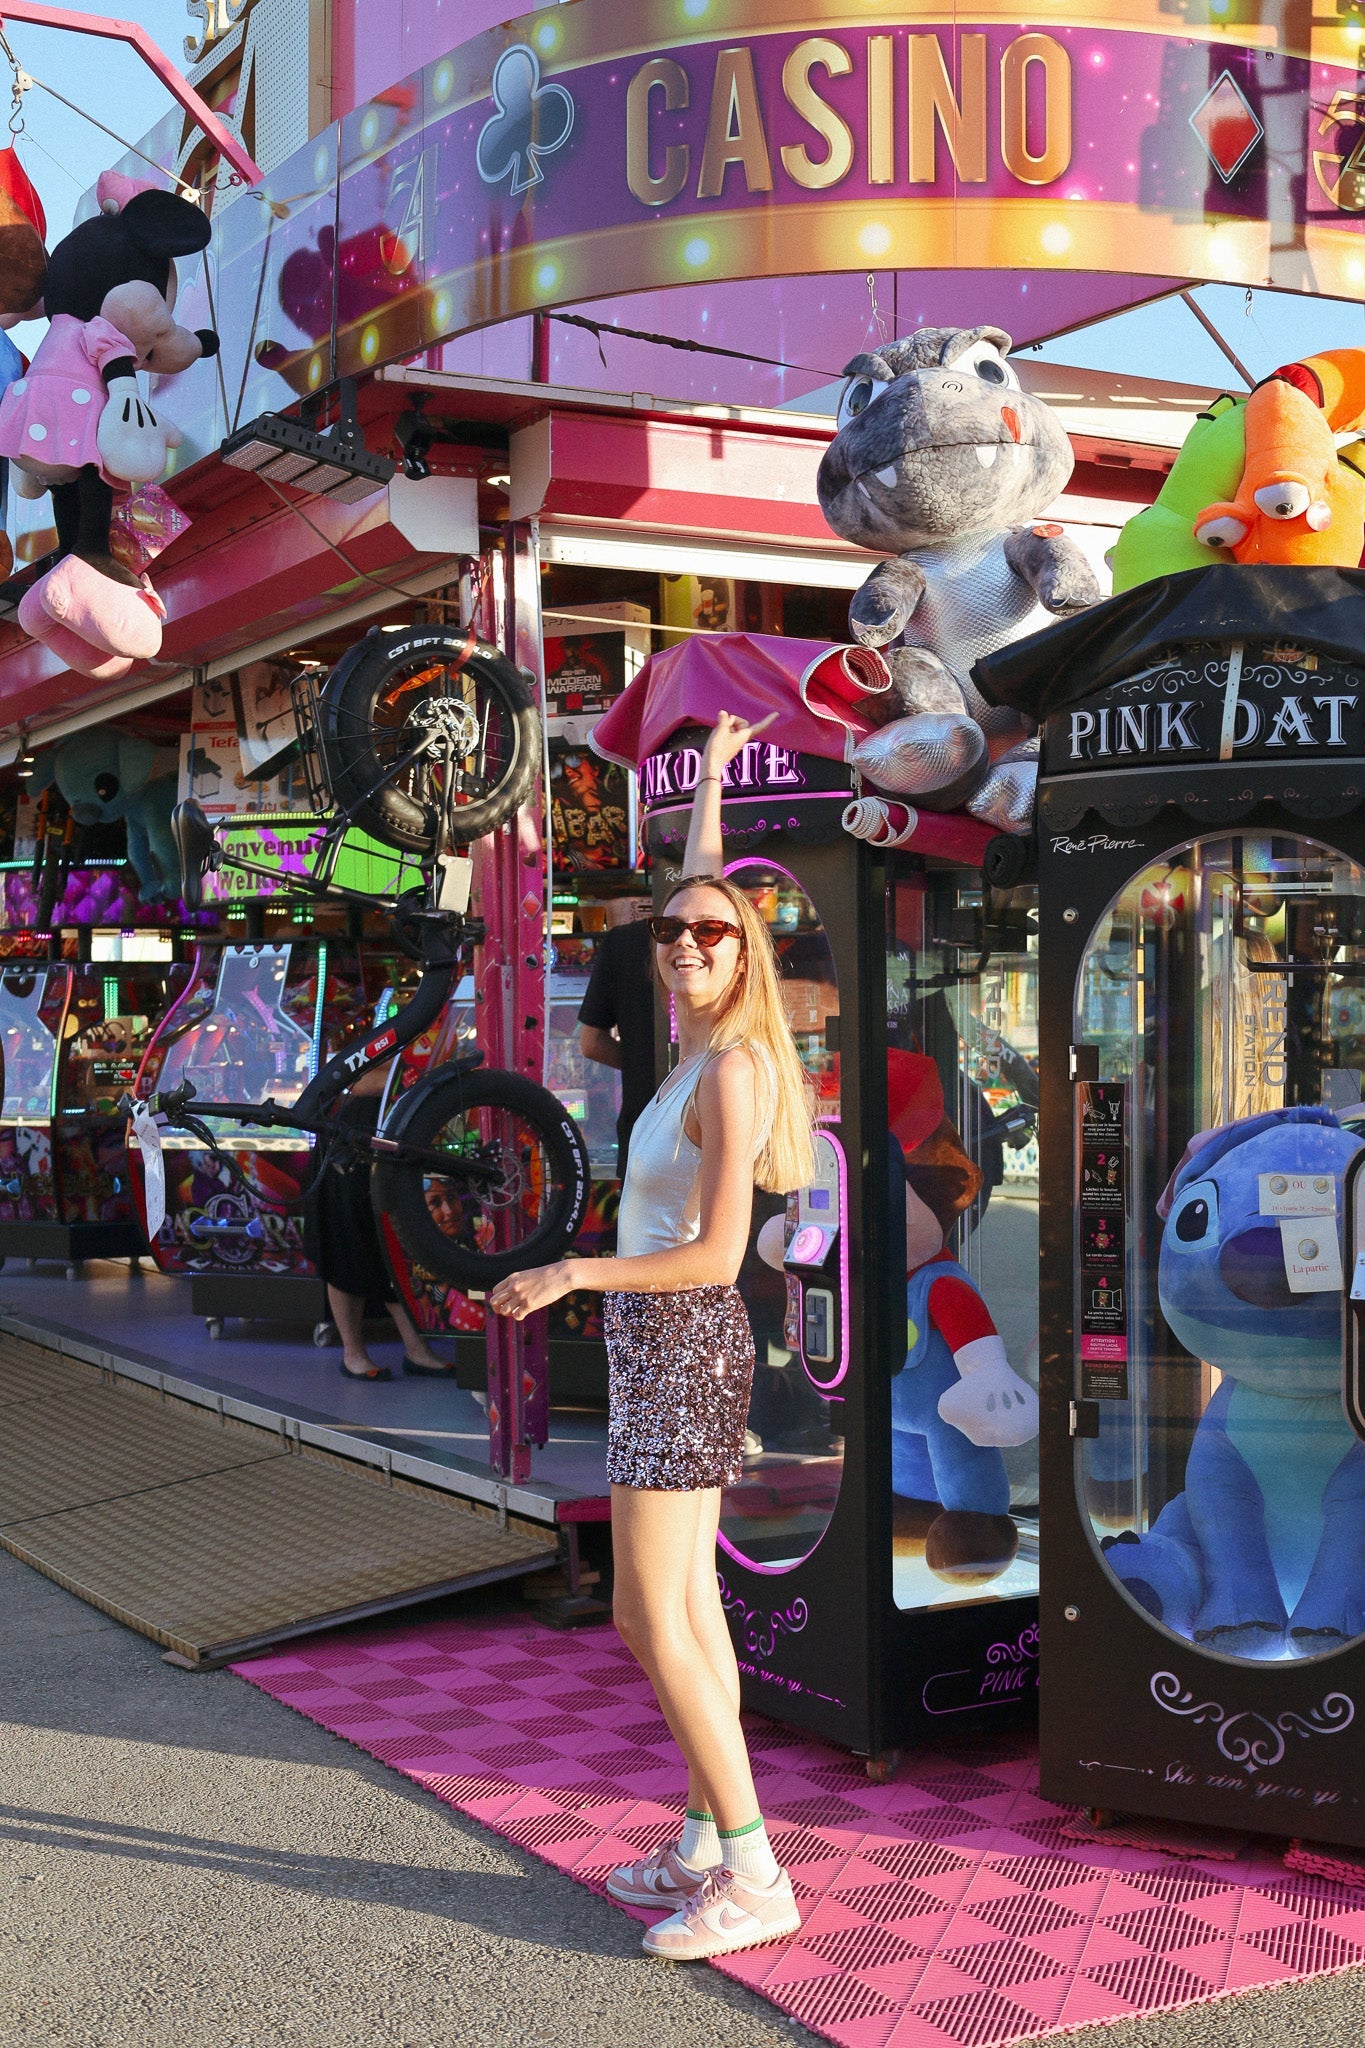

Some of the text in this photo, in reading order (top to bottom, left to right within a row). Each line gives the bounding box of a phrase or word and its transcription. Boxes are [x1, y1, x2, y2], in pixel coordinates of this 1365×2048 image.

[626, 33, 1072, 206] CASINO
[388, 642, 411, 660] CST
[413, 637, 441, 649] BFT
[547, 674, 601, 687] MODERN
[547, 683, 602, 695] WARFARE
[1068, 695, 1360, 760] PINK DAT
[209, 735, 239, 748] Tefa
[1086, 834, 1145, 858] Pierre
[1262, 955, 1294, 1087] TREND
[344, 1036, 389, 1072] TX RSI
[1244, 1014, 1256, 1087] STATION
[1098, 1089, 1105, 1100] 1
[561, 1121, 577, 1146] CST
[1097, 1153, 1106, 1165] 2
[1292, 1180, 1307, 1190] OU
[1098, 1219, 1107, 1231] 3
[1292, 1262, 1329, 1275] La partie
[1098, 1277, 1108, 1289] 4
[980, 1666, 1030, 1696] PINK
